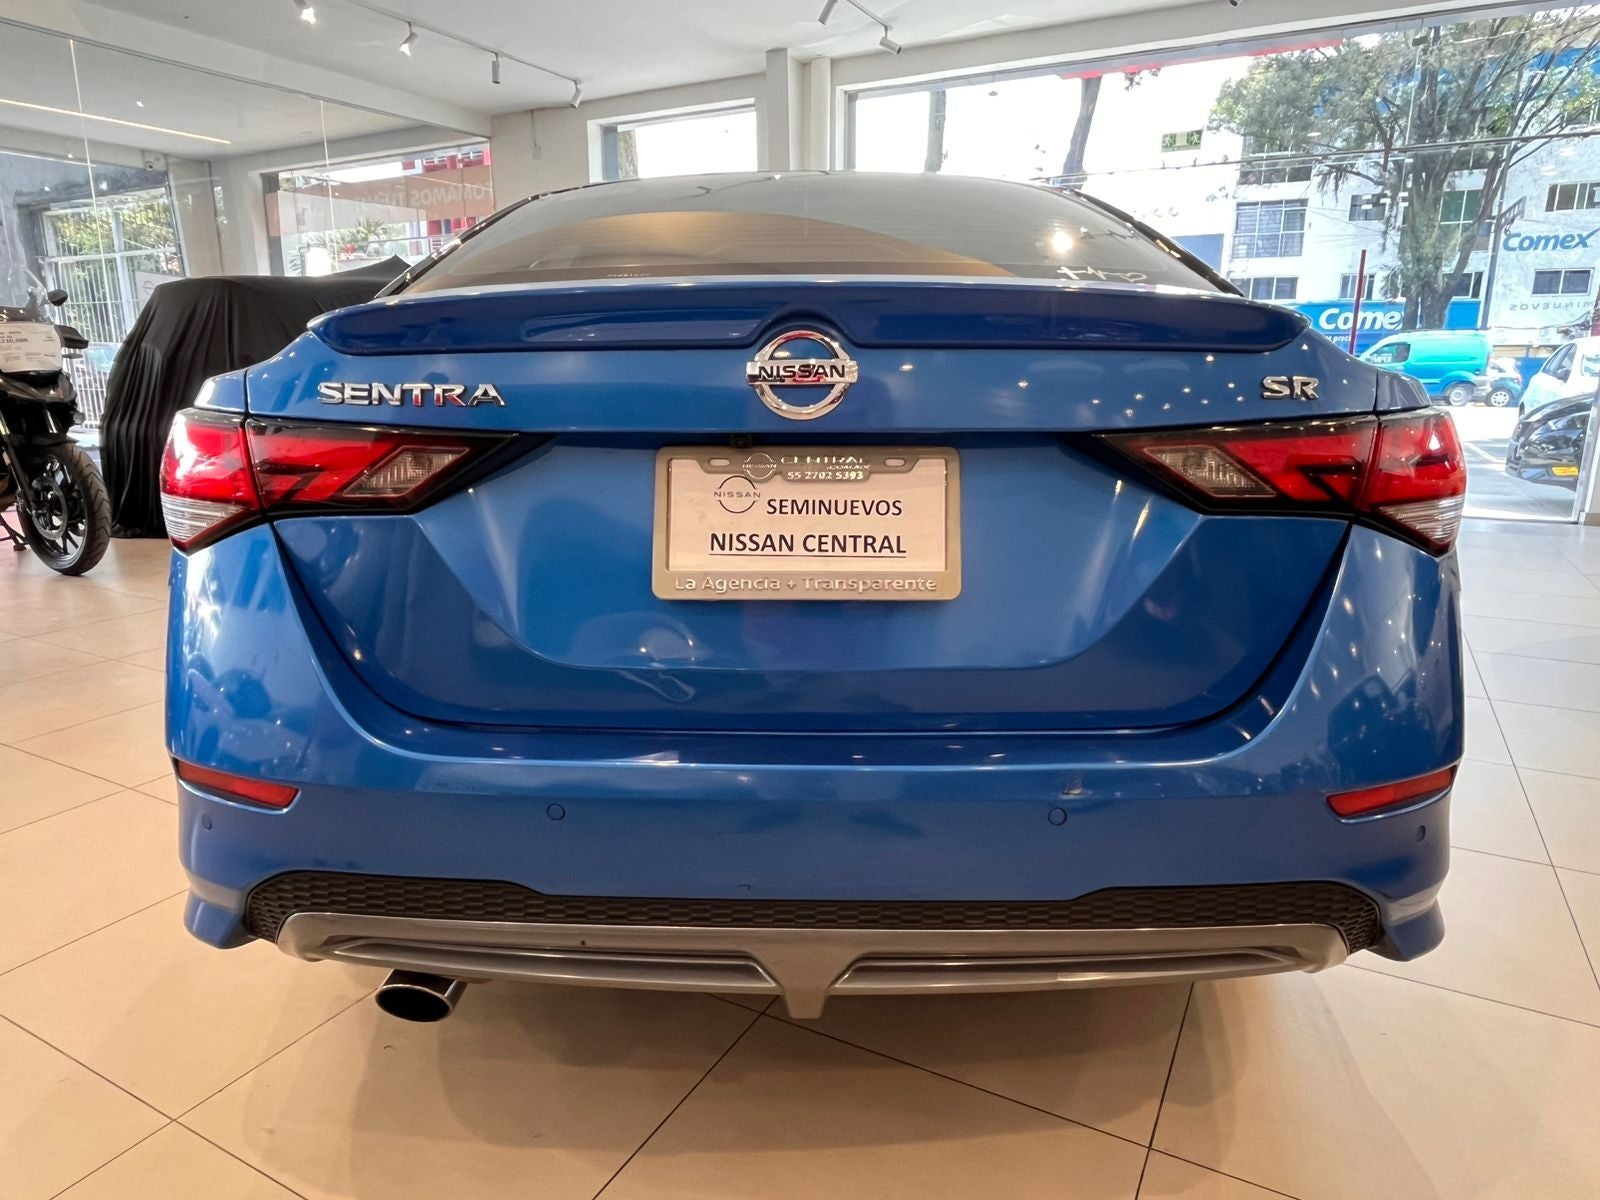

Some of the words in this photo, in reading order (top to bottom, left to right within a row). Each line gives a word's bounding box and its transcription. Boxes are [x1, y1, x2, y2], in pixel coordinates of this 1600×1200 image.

[1502, 228, 1600, 252] Comex
[1318, 307, 1405, 331] Come
[757, 363, 846, 380] NISSAN
[316, 382, 507, 407] SENTRA
[1262, 375, 1320, 400] SR
[786, 471, 802, 481] 55
[804, 471, 833, 481] 2702
[713, 491, 761, 499] NISSAN
[766, 498, 903, 516] SEMINUEVOS
[709, 533, 795, 552] NISSAN
[802, 534, 907, 554] CENTRAL
[674, 576, 697, 591] La
[701, 576, 781, 593] Agencia
[801, 576, 938, 593] Transparente
